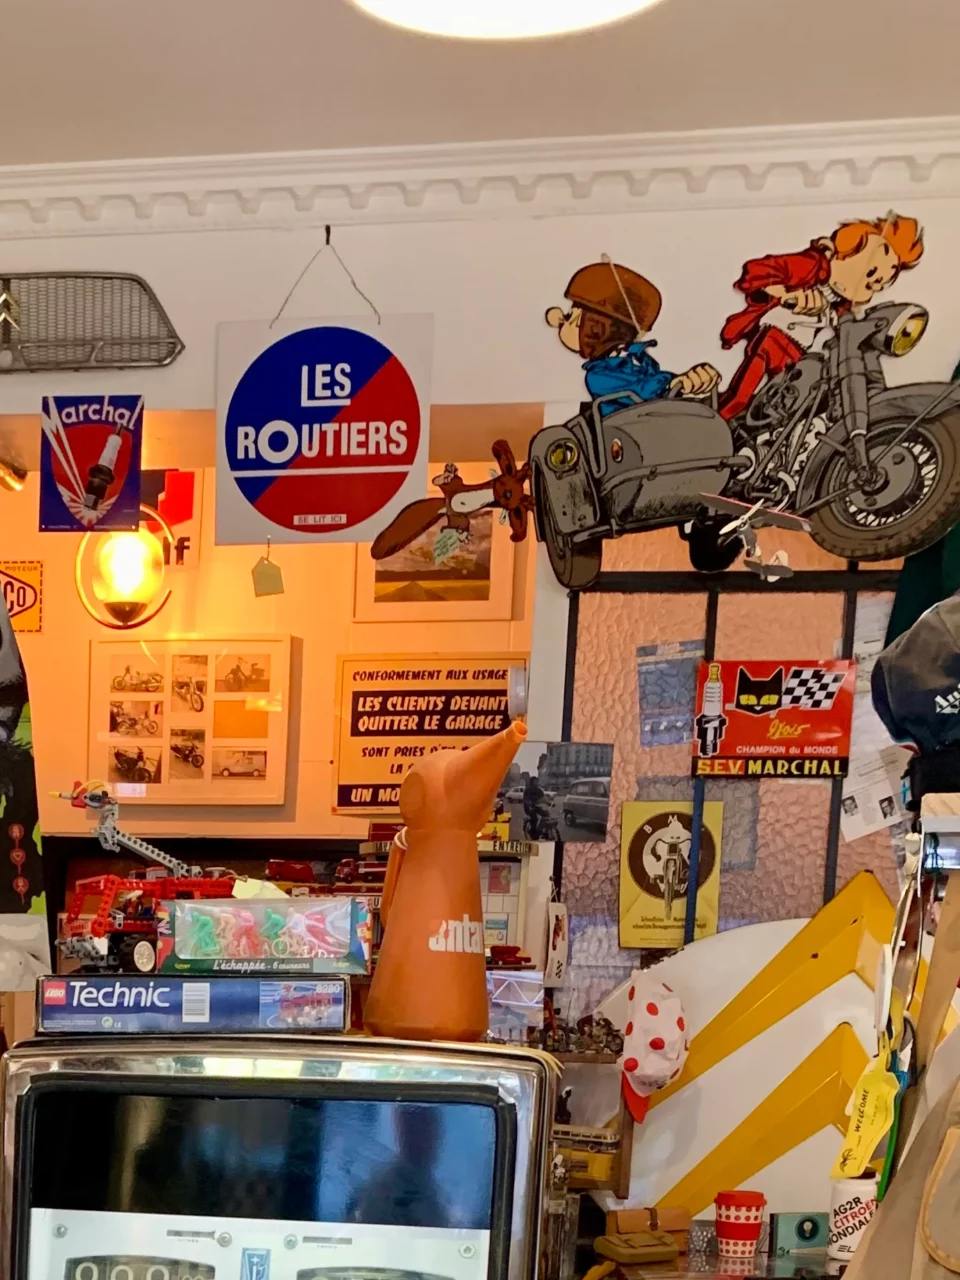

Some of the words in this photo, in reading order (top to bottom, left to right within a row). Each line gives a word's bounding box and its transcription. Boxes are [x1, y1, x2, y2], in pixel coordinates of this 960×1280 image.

[300, 363, 352, 406] LES
[41, 395, 144, 433] Marchal
[237, 419, 408, 464] ROUTIERS
[297, 515, 310, 524] SE
[313, 515, 327, 524] LIT
[330, 514, 343, 523] ICI
[163, 537, 190, 566] lf
[353, 670, 442, 682] CONFORMEMENT
[445, 669, 469, 680] AUX
[472, 669, 508, 680] USAGE
[358, 696, 382, 712] LES
[387, 696, 445, 711] CLIENTS
[450, 695, 508, 711] DEVANT
[358, 715, 419, 731] QUITTER
[424, 715, 440, 730] LE
[445, 714, 503, 730] GARAGE
[362, 747, 390, 757] SONT
[736, 746, 785, 754] CHAMPION
[790, 746, 800, 754] du
[804, 745, 838, 754] MONDE
[390, 763, 403, 774] LA
[748, 759, 842, 775] MARCHAL
[351, 788, 372, 802] UN
[213, 958, 266, 972] L'échappée
[45, 987, 65, 998] LEGO
[70, 982, 170, 1007] Technic
[316, 984, 340, 994] 8280
[833, 1197, 863, 1219] AG2R
